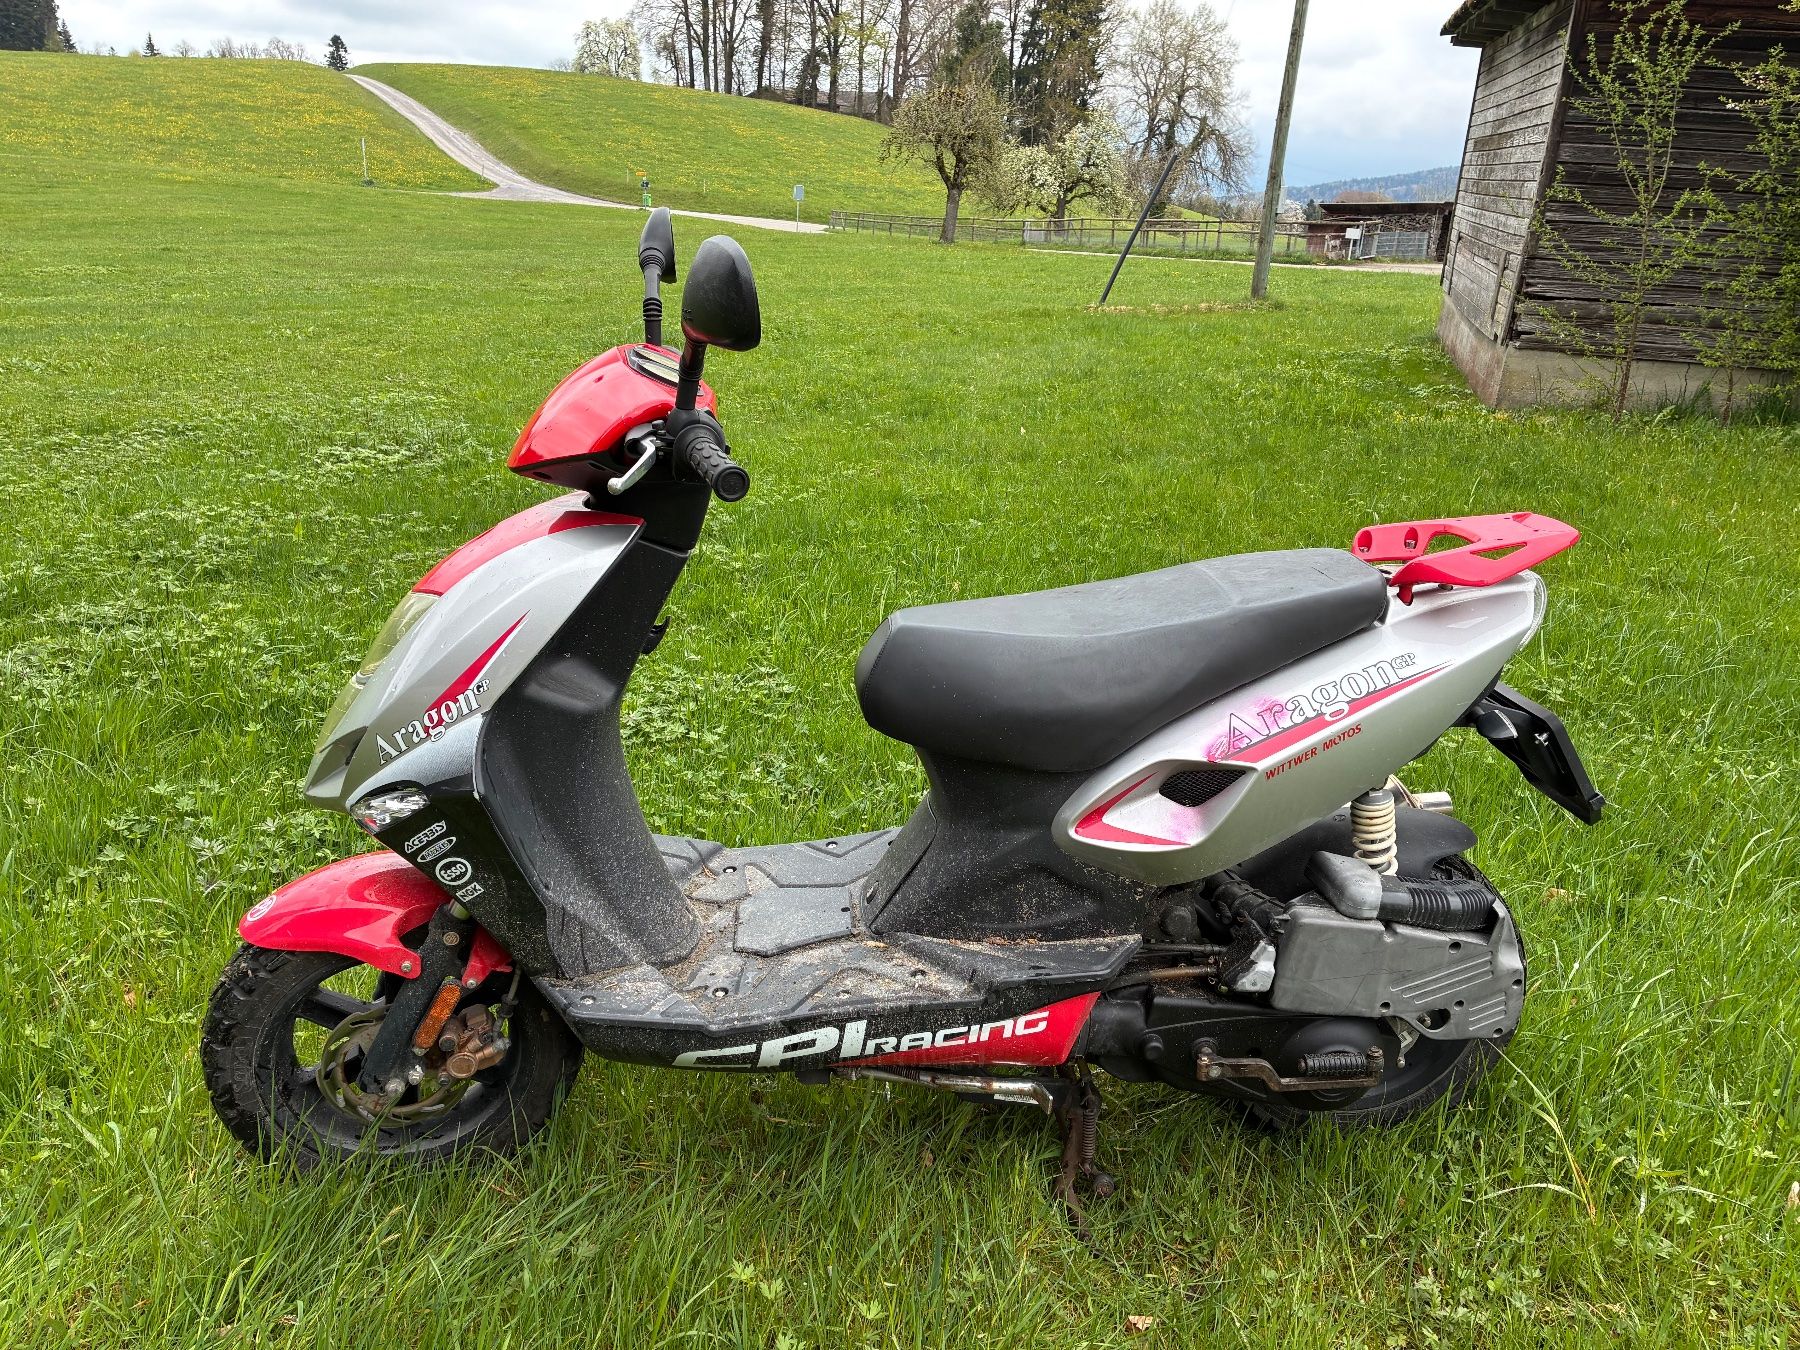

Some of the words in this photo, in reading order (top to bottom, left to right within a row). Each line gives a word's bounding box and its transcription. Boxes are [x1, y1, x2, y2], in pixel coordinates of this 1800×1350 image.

[376, 688, 482, 766] Aragon
[1226, 659, 1404, 752] Aragon
[1265, 747, 1318, 780] WITTWER
[1322, 724, 1362, 751] MOTOS
[458, 884, 482, 901] NGK
